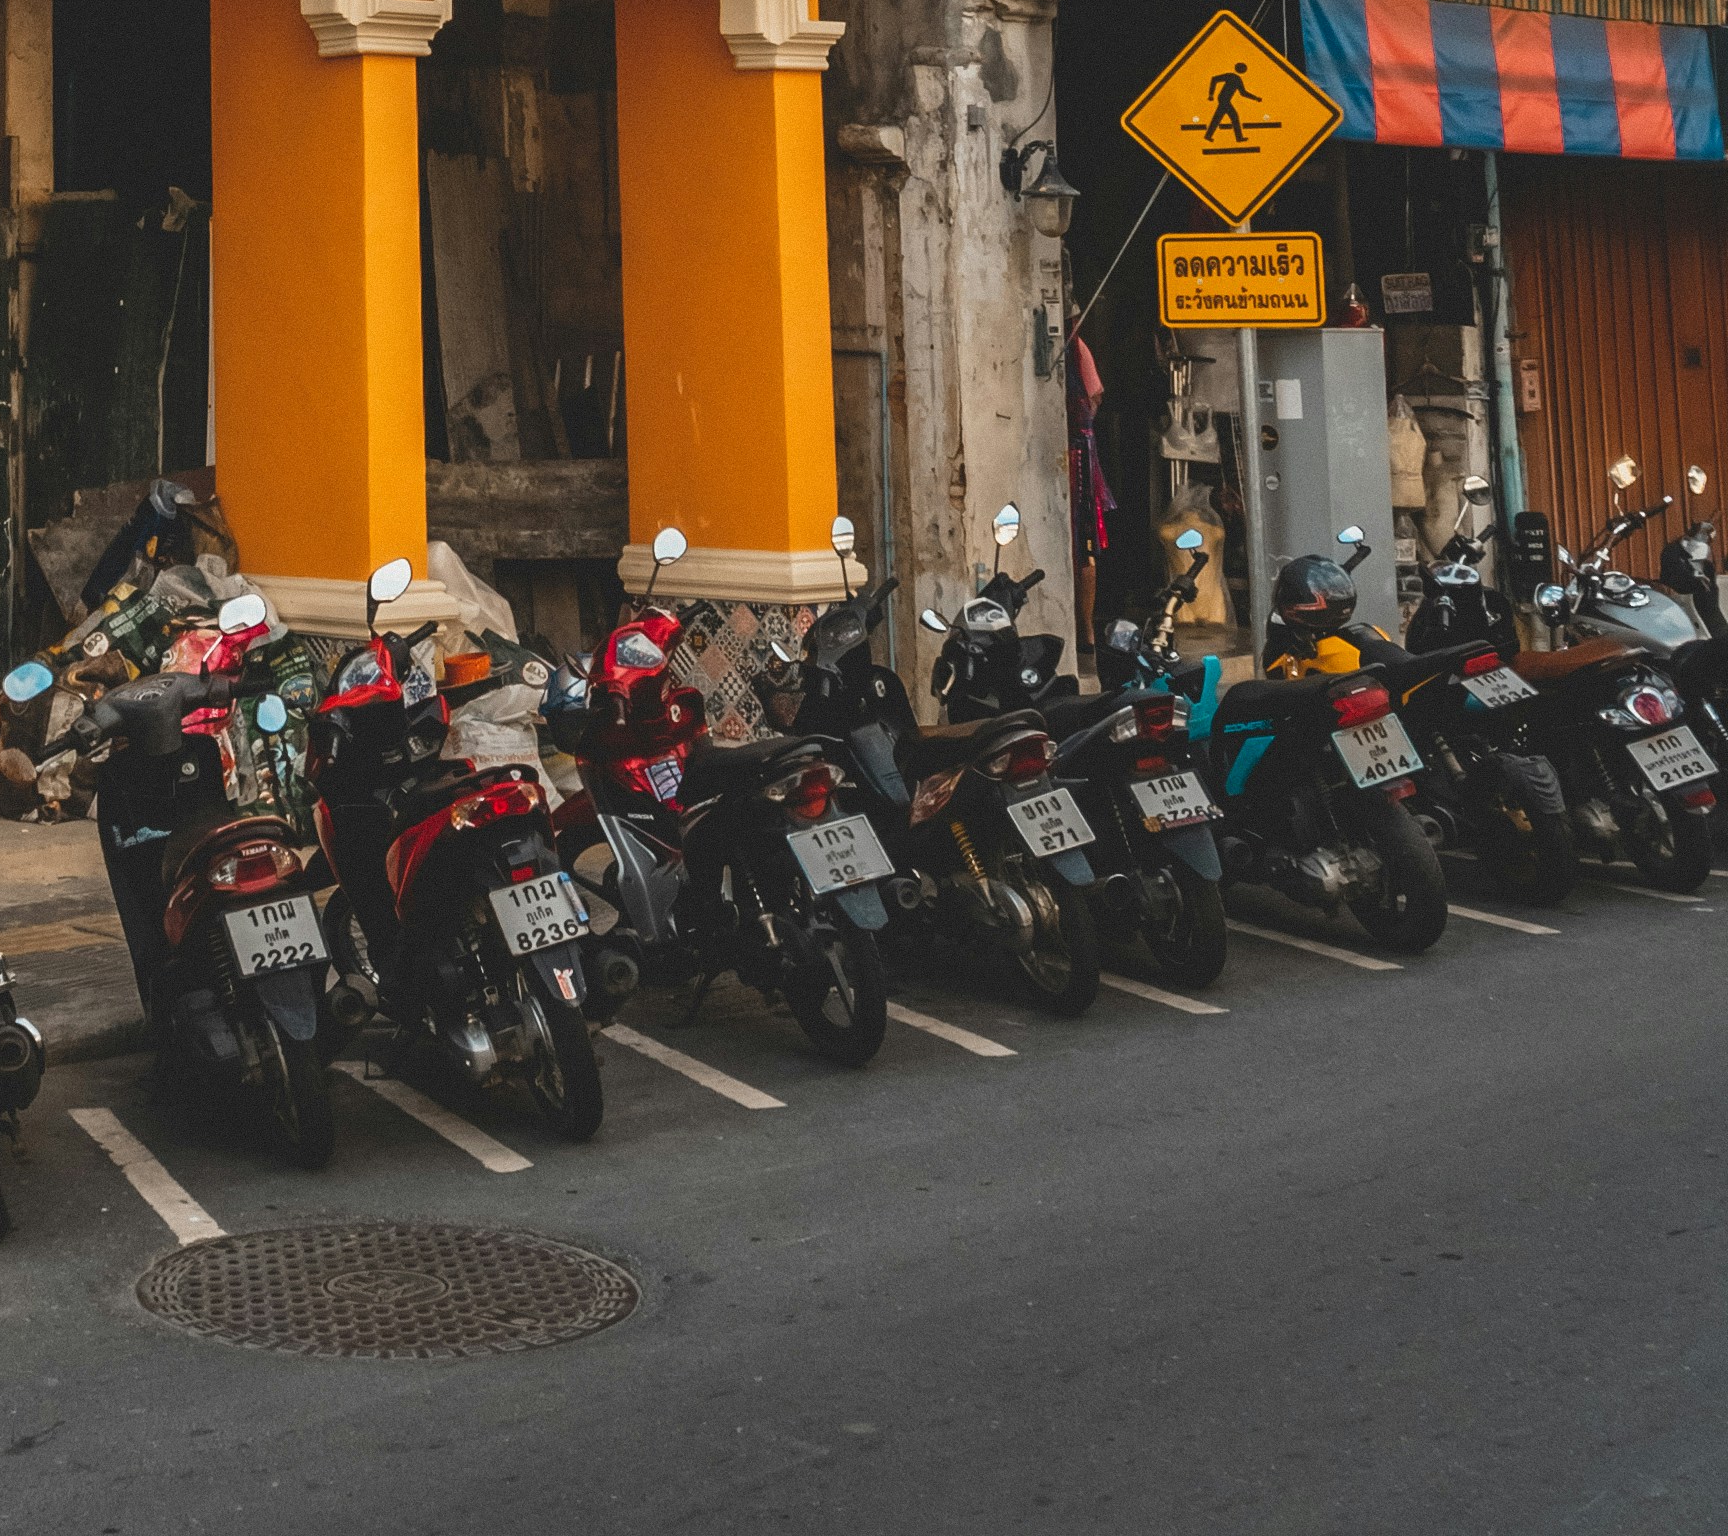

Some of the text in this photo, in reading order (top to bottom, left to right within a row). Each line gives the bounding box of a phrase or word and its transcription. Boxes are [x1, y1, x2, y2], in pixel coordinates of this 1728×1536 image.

[1173, 243, 1304, 278] ลดความเร็ว
[1175, 286, 1309, 309] ระวังคนข้ามถนน
[1364, 755, 1411, 781] 4014
[1660, 761, 1705, 784] 2163
[1039, 827, 1079, 850] 271
[526, 906, 553, 926] ภูเก็ต
[516, 919, 578, 950] 8236
[251, 942, 316, 969] 2222
